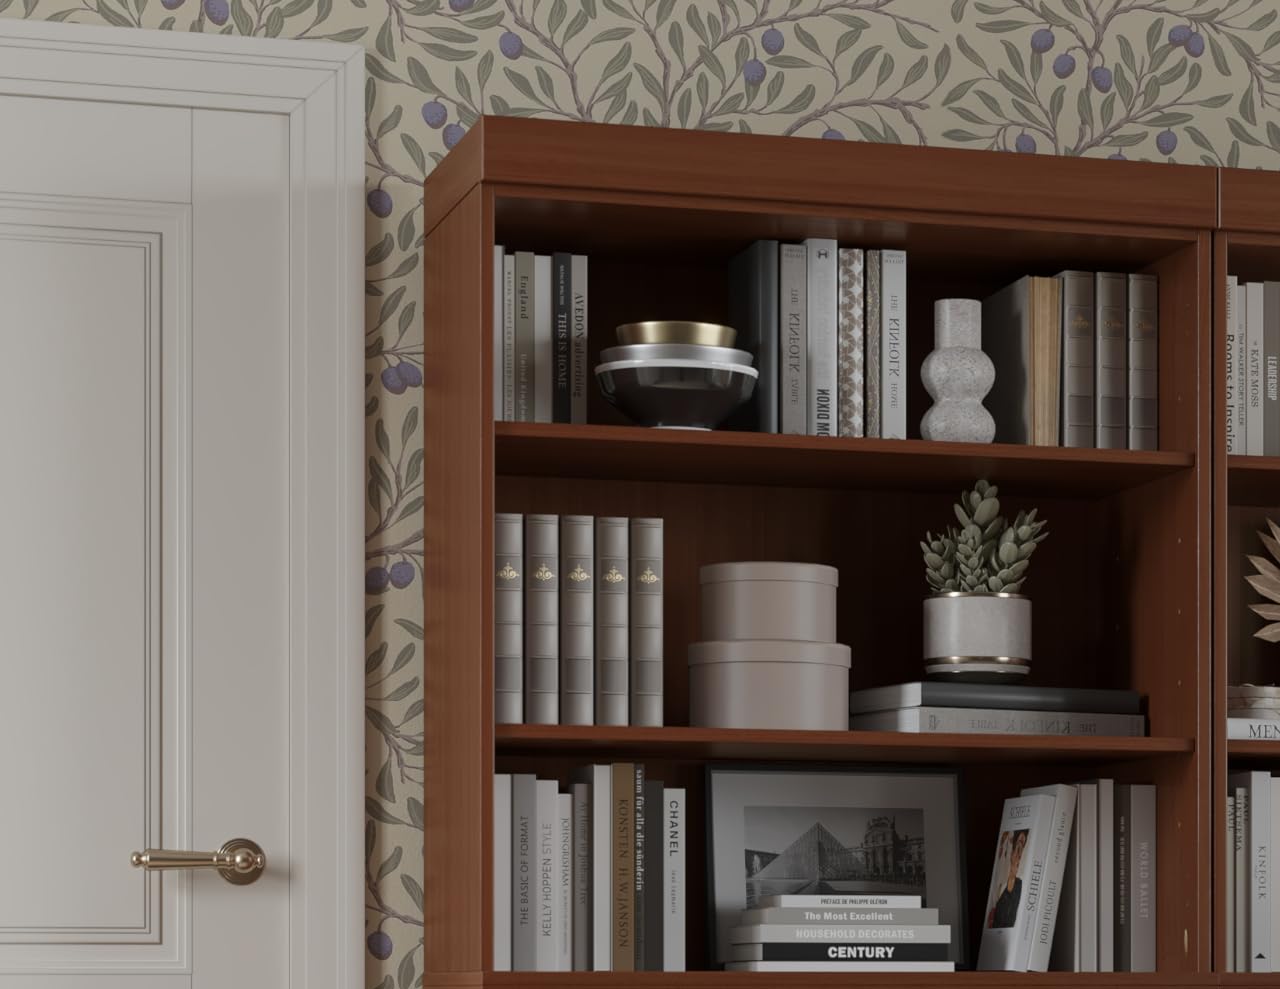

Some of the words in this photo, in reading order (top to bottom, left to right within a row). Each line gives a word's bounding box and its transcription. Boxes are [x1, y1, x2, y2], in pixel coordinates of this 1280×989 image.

[518, 275, 529, 319] England
[557, 313, 567, 338] THIS
[574, 292, 585, 338] AVEDON
[1249, 349, 1259, 377] KATE
[1267, 355, 1278, 400] LEADERSHIP
[1249, 380, 1259, 408] MOSS
[542, 823, 552, 855] STYLE
[617, 799, 629, 858] KONSTEN
[669, 800, 679, 857] CHANEL
[542, 859, 552, 900] HOPPEN
[1256, 846, 1267, 901] KINFOLK
[519, 877, 529, 903] BASIC
[519, 907, 529, 926] THE
[542, 904, 552, 937] KELLY
[805, 911, 821, 921] The
[823, 911, 848, 921] Most
[850, 911, 893, 921] Excellent
[796, 928, 855, 939] HOUSEHOLD
[858, 928, 914, 939] DECORATES
[828, 946, 895, 959] CENTURY
